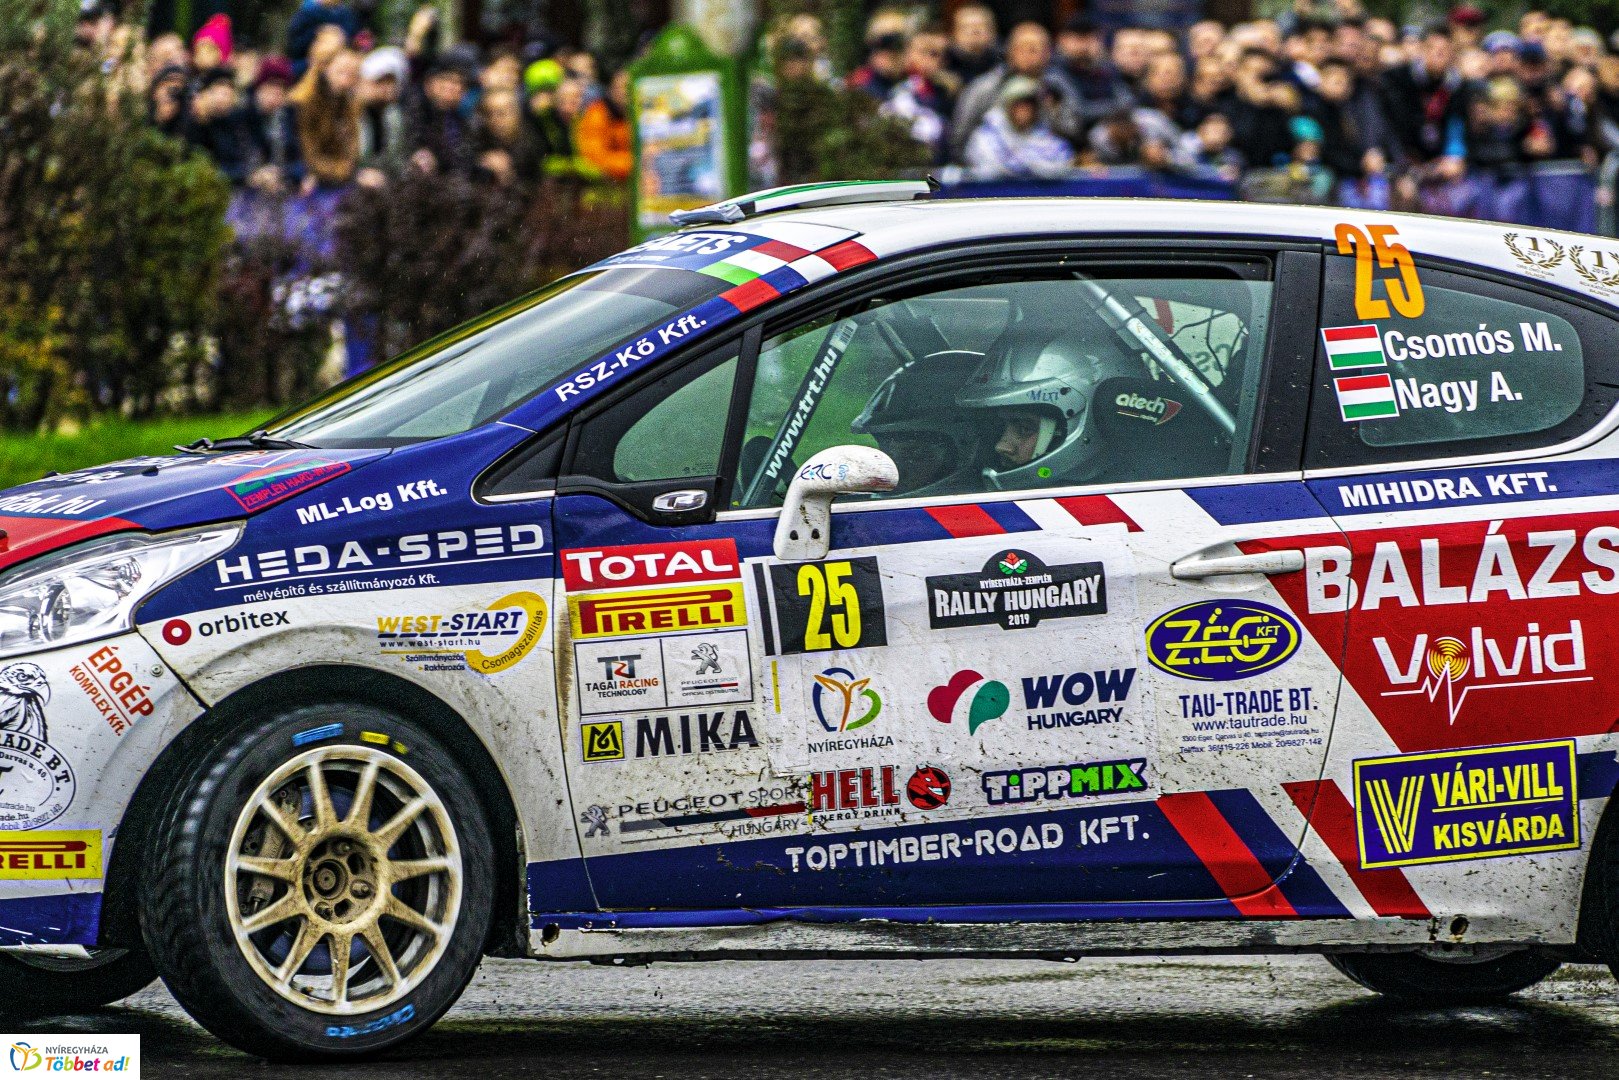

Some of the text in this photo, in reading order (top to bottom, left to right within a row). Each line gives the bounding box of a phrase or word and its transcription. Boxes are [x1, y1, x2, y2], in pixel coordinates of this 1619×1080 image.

[1334, 223, 1425, 320] 25
[657, 313, 708, 346] Kft.
[1384, 321, 1563, 361] Csomós M.
[1394, 371, 1524, 414] Nagy A.
[765, 348, 838, 480] www.trt.hu
[297, 479, 448, 525] ML-Log Kft.
[1338, 471, 1558, 508] MIHIDRA KFT.
[214, 524, 545, 585] HEDA-SPED
[566, 548, 735, 583] TOTAL
[1304, 519, 1619, 615] BALÁZS
[243, 574, 441, 603] mélyépítő és szállítmányozó Kft.
[797, 561, 862, 651] 25
[934, 574, 1101, 618] RALLY HUNGARY
[198, 607, 291, 637] orbitex
[376, 611, 523, 634] WEST-START
[577, 588, 735, 635] PIRELLI
[1008, 613, 1030, 626] 2019
[379, 638, 481, 648] www.west-start.hu
[1256, 625, 1281, 637] KFT
[88, 646, 155, 717] ÉPGÉP
[585, 677, 660, 692] TAGAI RACING
[597, 688, 648, 698] TECHNOLOGY
[1021, 667, 1138, 710] WOW
[69, 665, 126, 737] KOMPLEX Kft.
[1027, 706, 1124, 731] HUNGARY
[1178, 687, 1318, 719] TAU-TRADE BT.
[635, 710, 760, 758] MIKA
[1192, 713, 1308, 732] www.tautrade.hu
[807, 735, 894, 754] NYÍREGYHÁZA
[811, 764, 901, 812] HELL
[1430, 762, 1564, 807] VÁRI-VILL
[619, 790, 744, 818] PEUGEOT
[812, 807, 901, 822] ENERGY DRINK
[731, 819, 800, 836] HUNGARY
[786, 814, 1150, 874] TOPTIMBER-ROAD KFT.
[1432, 813, 1565, 850] KISVÁRDA
